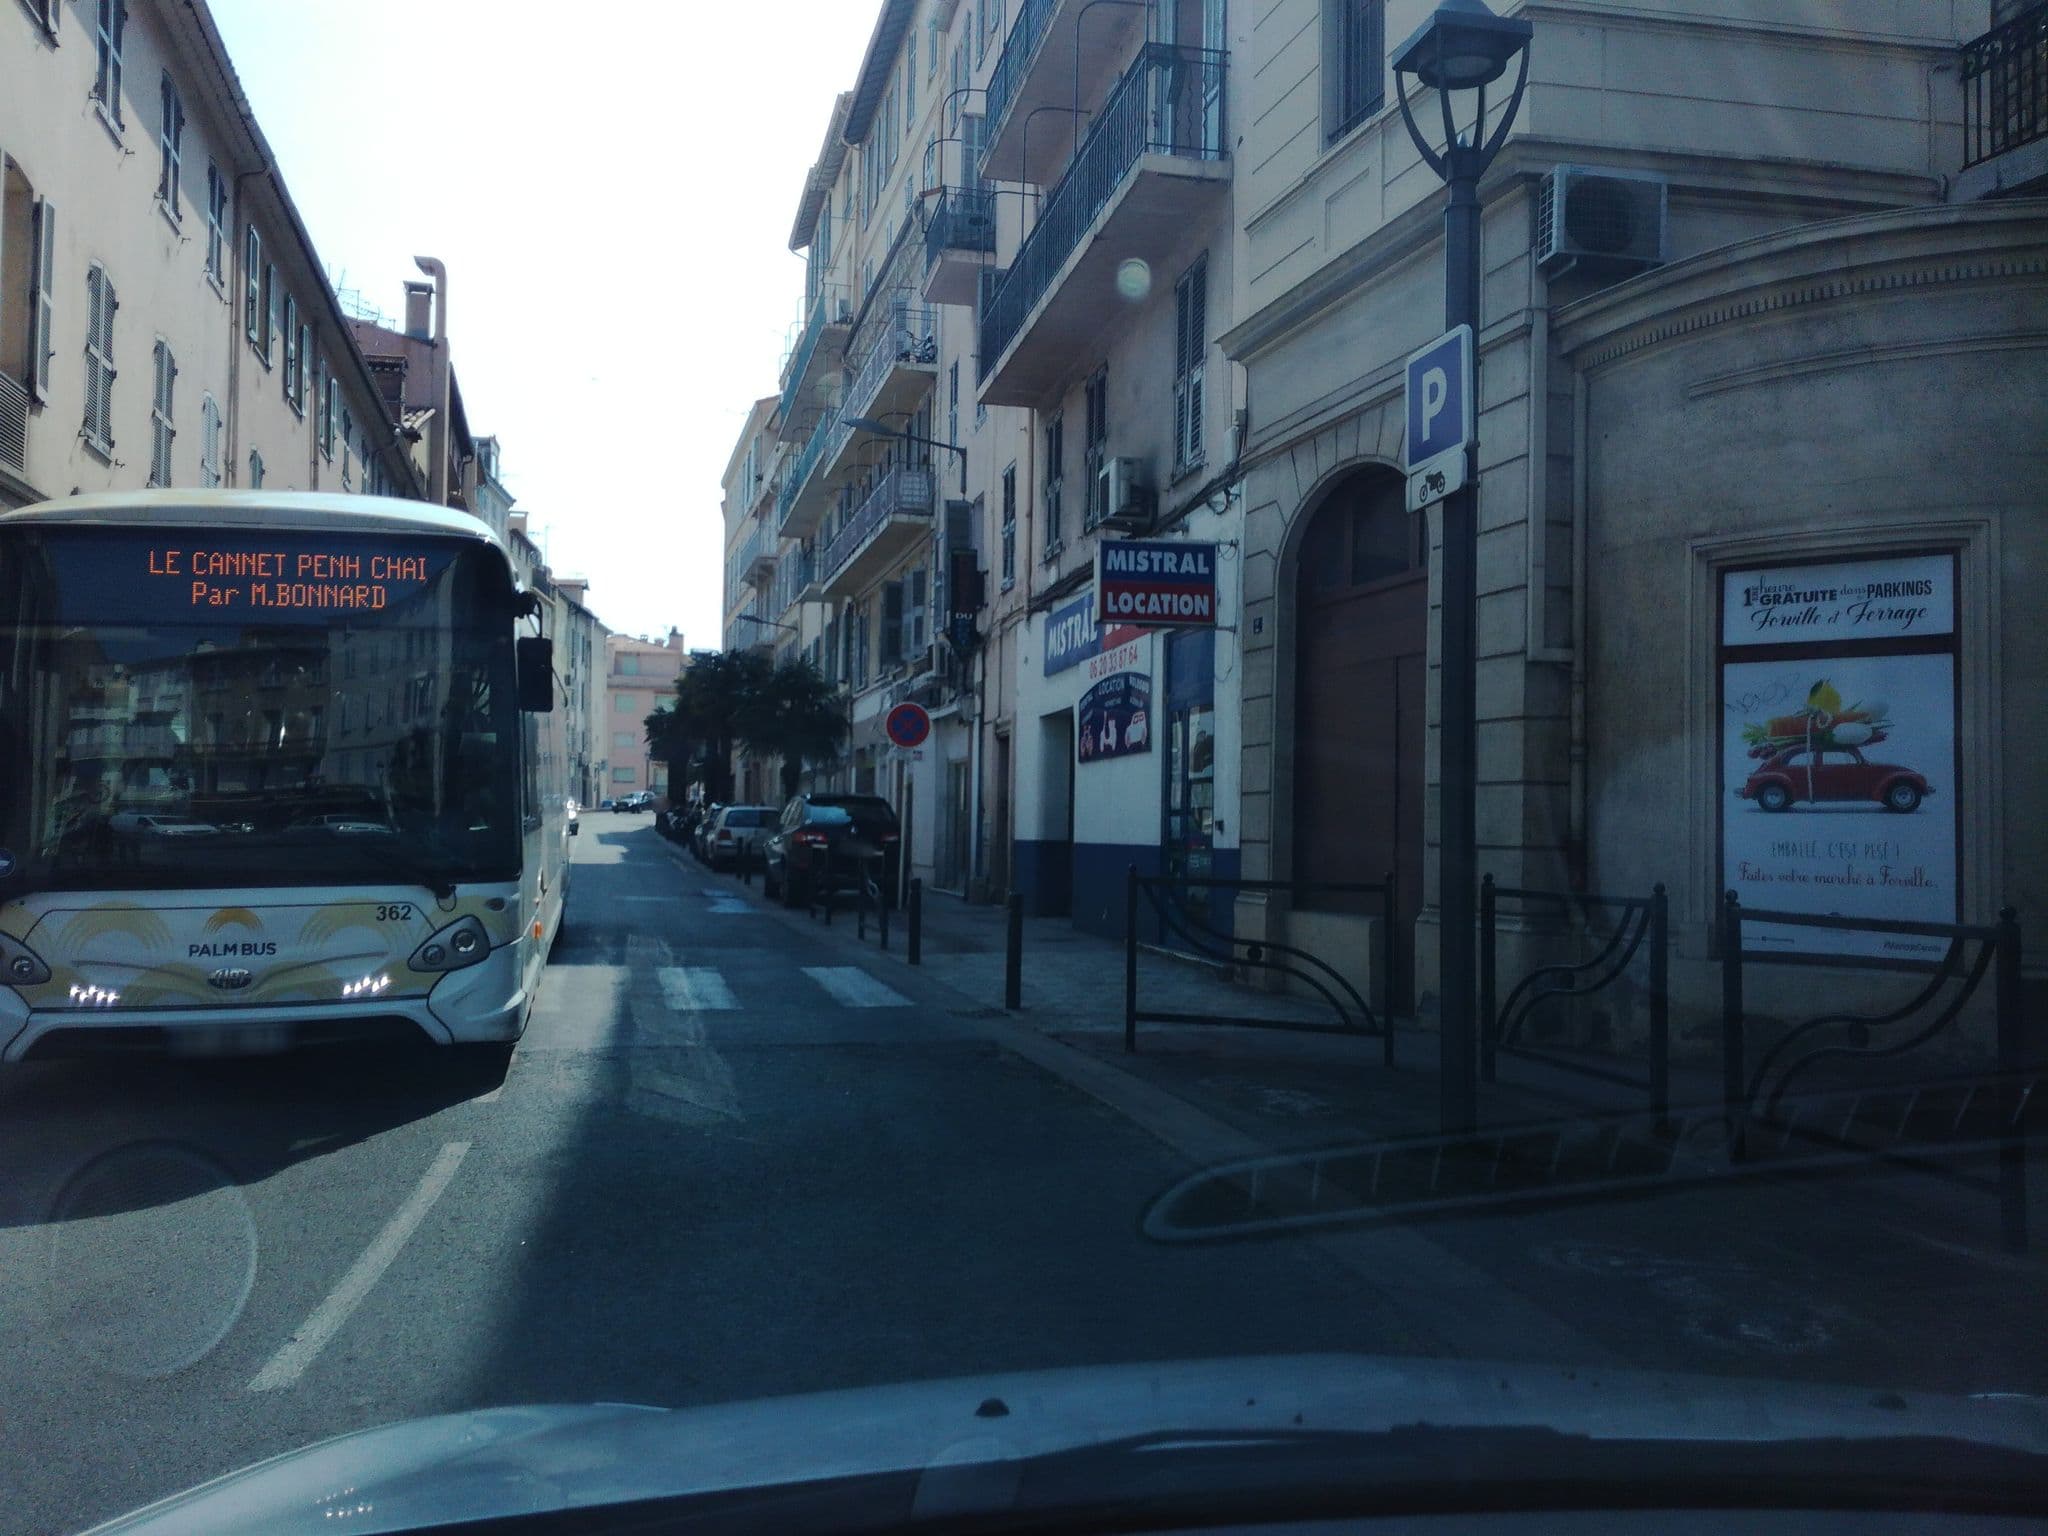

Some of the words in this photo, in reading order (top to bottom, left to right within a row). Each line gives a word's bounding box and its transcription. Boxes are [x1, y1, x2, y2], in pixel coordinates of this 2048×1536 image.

[1422, 367, 1448, 442] P
[150, 551, 181, 574] LE
[192, 552, 286, 577] CANNET
[299, 554, 360, 578] PENH
[371, 556, 427, 580] CHAI
[1106, 549, 1209, 575] MISTRAL
[192, 581, 240, 606] Par
[251, 583, 386, 609] M.BONNARD
[1106, 591, 1209, 617] LOCATION
[1760, 589, 1837, 606] GRATUITE
[1867, 579, 1932, 598] PARKINGS
[1846, 600, 1928, 630] Ferrage
[1048, 607, 1098, 660] MISTRAL
[376, 905, 411, 921] 362
[188, 943, 238, 957] PALM
[241, 942, 277, 956] BUS
